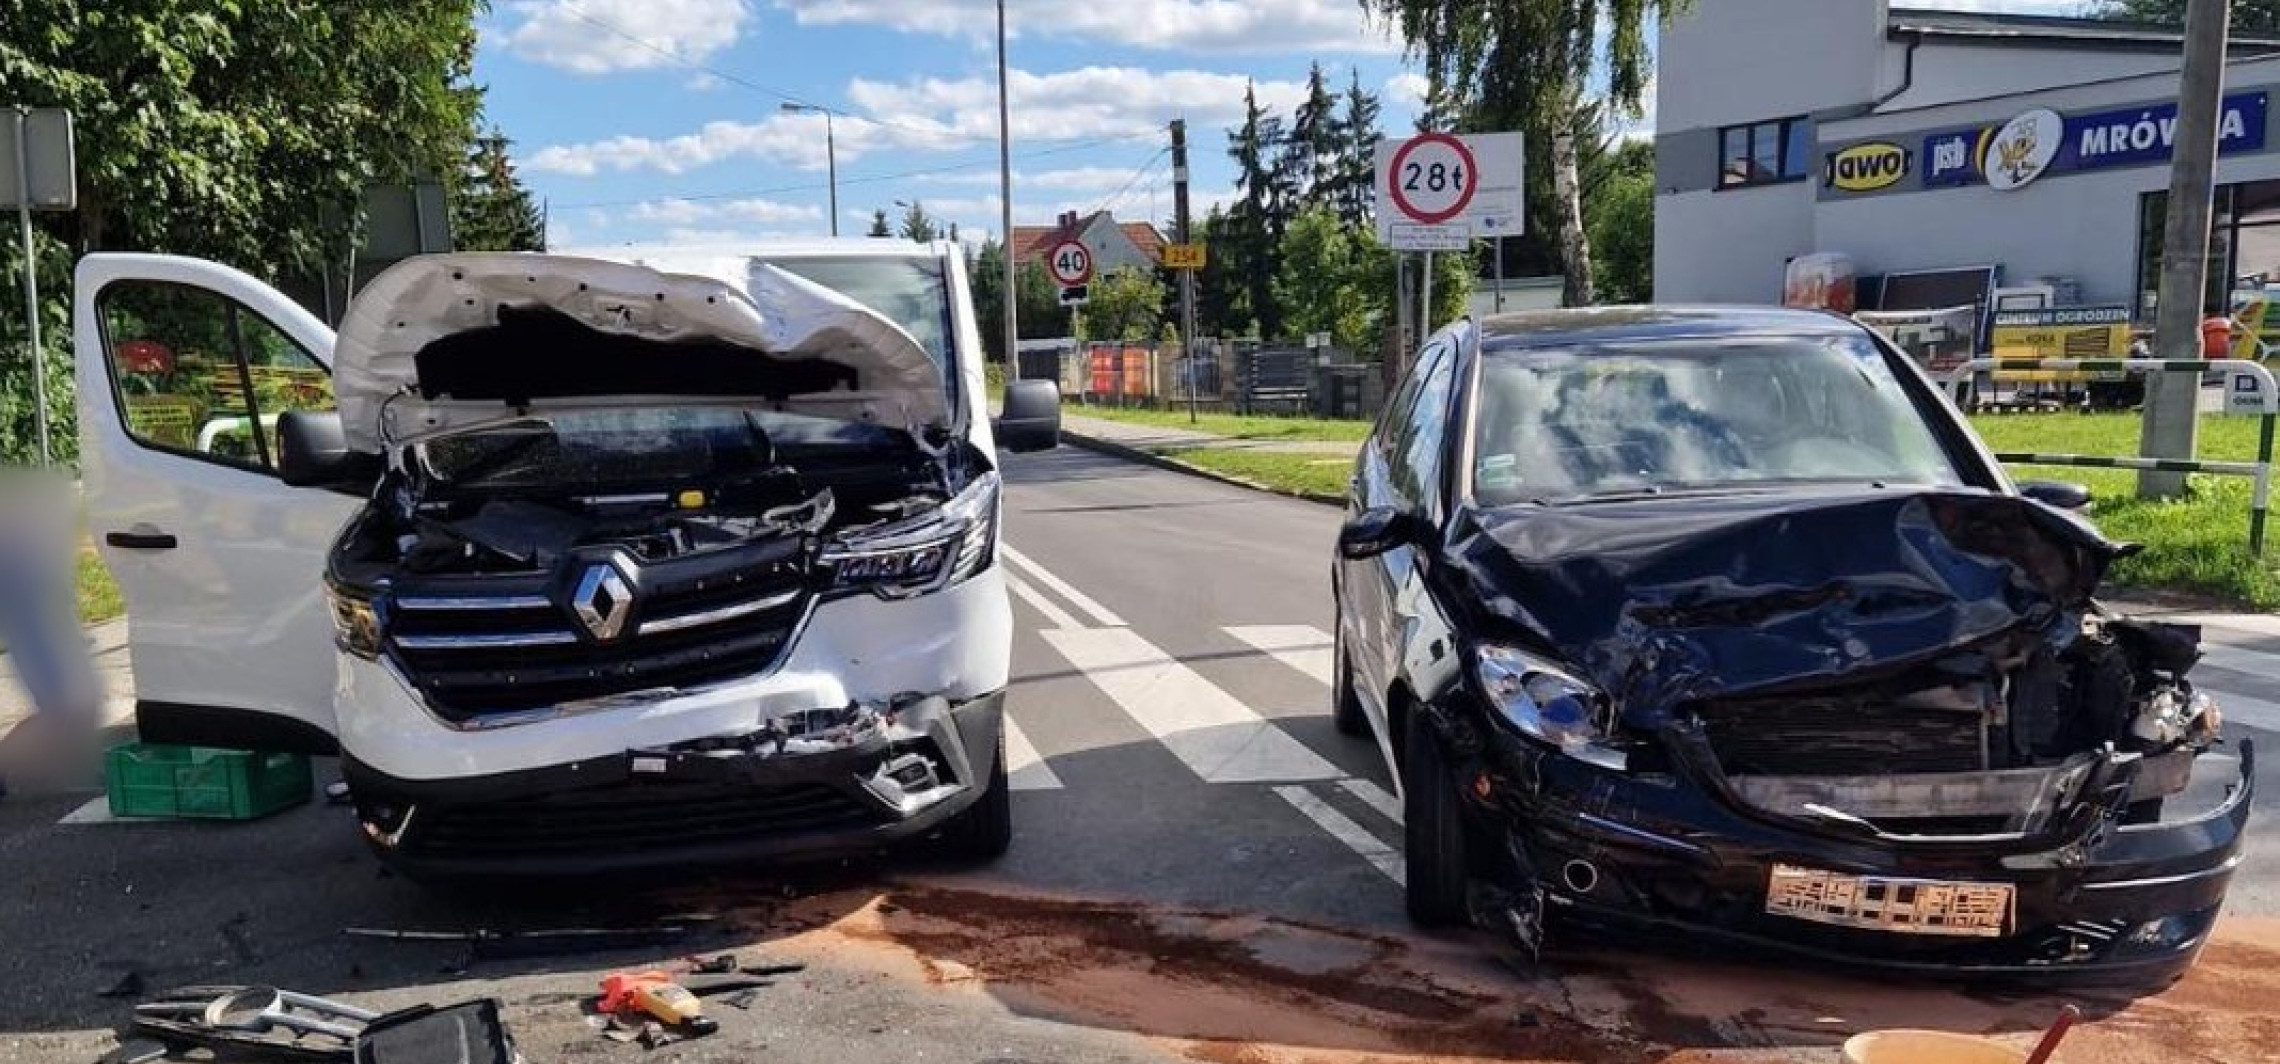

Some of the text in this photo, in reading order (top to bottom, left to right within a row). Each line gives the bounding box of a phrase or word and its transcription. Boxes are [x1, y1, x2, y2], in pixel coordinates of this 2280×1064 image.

[2080, 109, 2245, 156] MRÓWA
[1933, 136, 1966, 176] psb
[1058, 251, 1085, 272] 40
